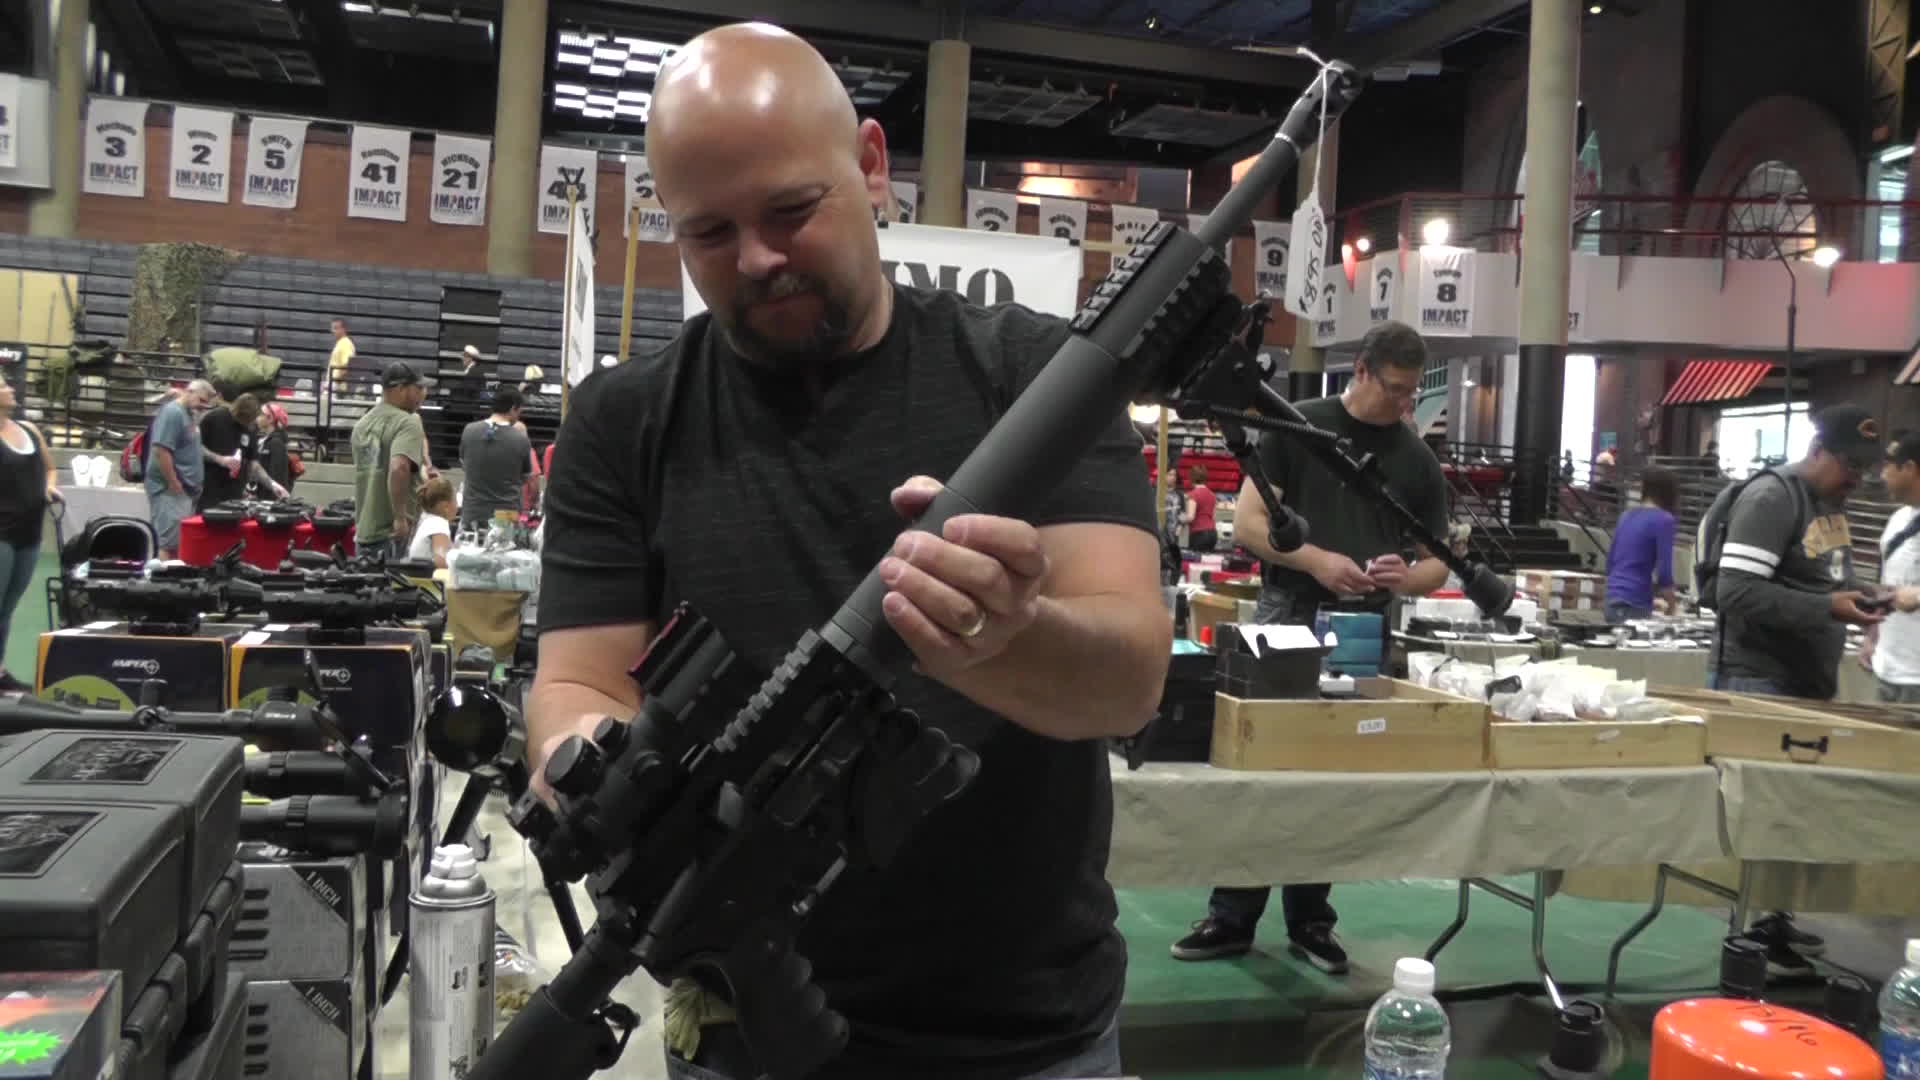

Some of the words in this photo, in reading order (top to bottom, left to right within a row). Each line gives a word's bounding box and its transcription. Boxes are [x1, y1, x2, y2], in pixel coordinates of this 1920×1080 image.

[105, 136, 126, 158] 3
[192, 144, 211, 165] 2
[264, 148, 286, 170] 5
[90, 162, 138, 180] IMPACT
[176, 168, 224, 188] IMPACT
[361, 162, 397, 185] 41
[442, 168, 478, 190] 21
[249, 175, 296, 193] IMPACT
[355, 187, 401, 205] IMPACT
[435, 193, 481, 210] IMPACT
[1437, 283, 1457, 303] 8
[1423, 308, 1469, 323] IMPACT
[312, 877, 341, 907] INCH
[311, 992, 341, 1020] INCH
